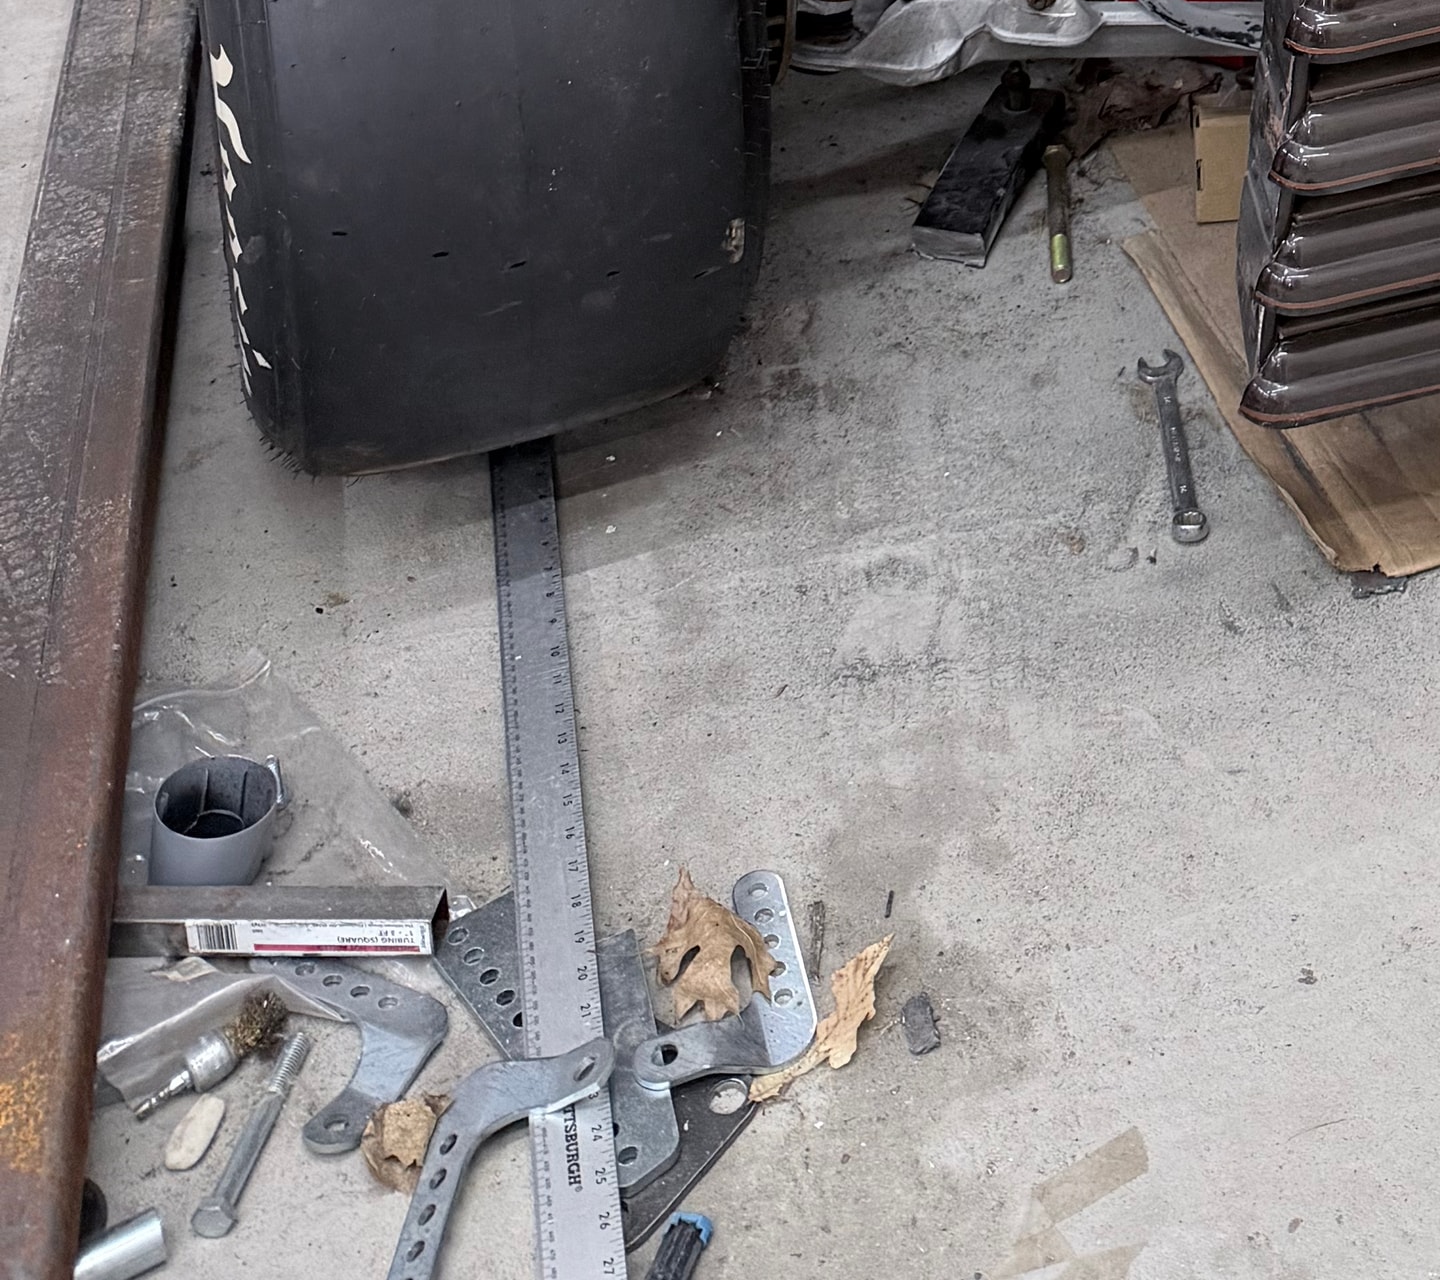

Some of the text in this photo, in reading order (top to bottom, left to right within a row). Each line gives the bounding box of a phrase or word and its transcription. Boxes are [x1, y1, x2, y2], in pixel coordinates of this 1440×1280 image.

[550, 645, 561, 657] 10
[555, 702, 565, 714] 12
[557, 732, 568, 745] 13
[560, 762, 570, 775] 14
[562, 793, 573, 807] 15
[565, 826, 575, 840] 16
[568, 860, 579, 872] 17
[571, 894, 582, 908] 18
[380, 936, 416, 944] TUBING
[574, 929, 585, 944] 19
[577, 965, 588, 981] 20
[580, 1002, 592, 1018] 21
[591, 1124, 603, 1142] 24
[562, 1103, 582, 1186] TTSBURGH
[595, 1167, 607, 1185] 25
[598, 1211, 611, 1230] 26
[603, 1257, 616, 1275] 27
